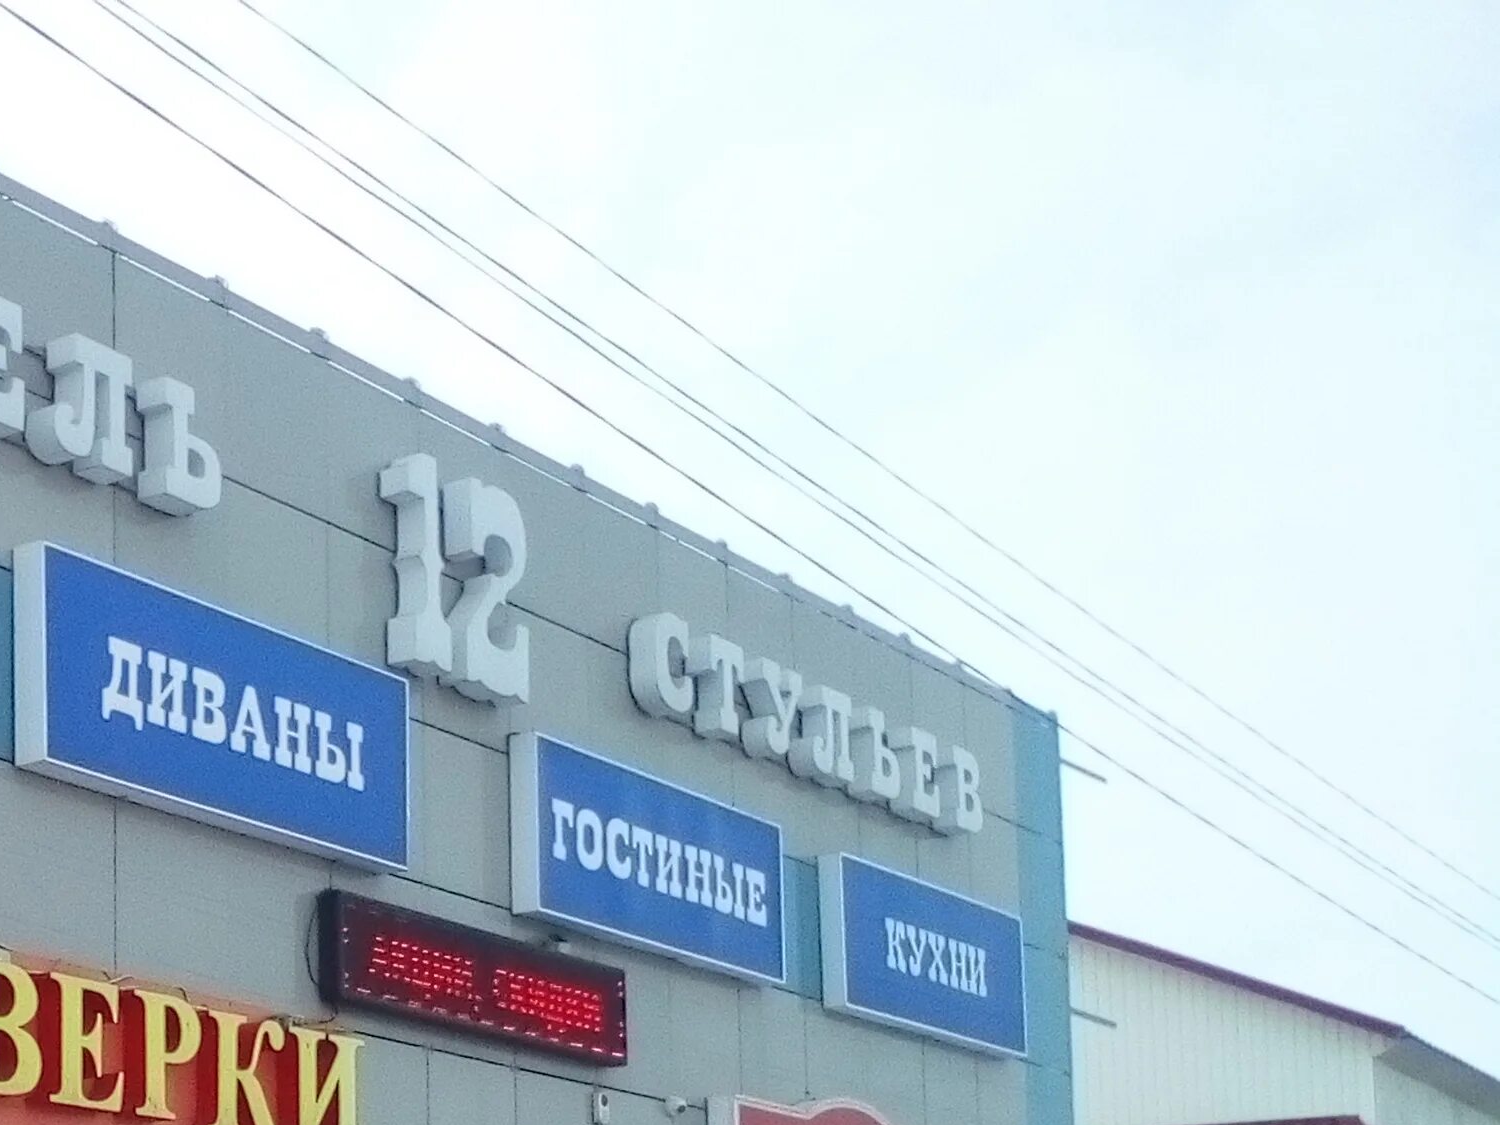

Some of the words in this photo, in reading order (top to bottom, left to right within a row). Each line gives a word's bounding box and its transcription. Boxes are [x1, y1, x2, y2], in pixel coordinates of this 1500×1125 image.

[102, 636, 365, 792] ДИВАНЫ
[378, 453, 530, 706] 12
[629, 611, 984, 836] СТУЛЬЕВ
[551, 799, 768, 928] ГОСТИНЫЕ
[885, 917, 988, 998] КУХНИ
